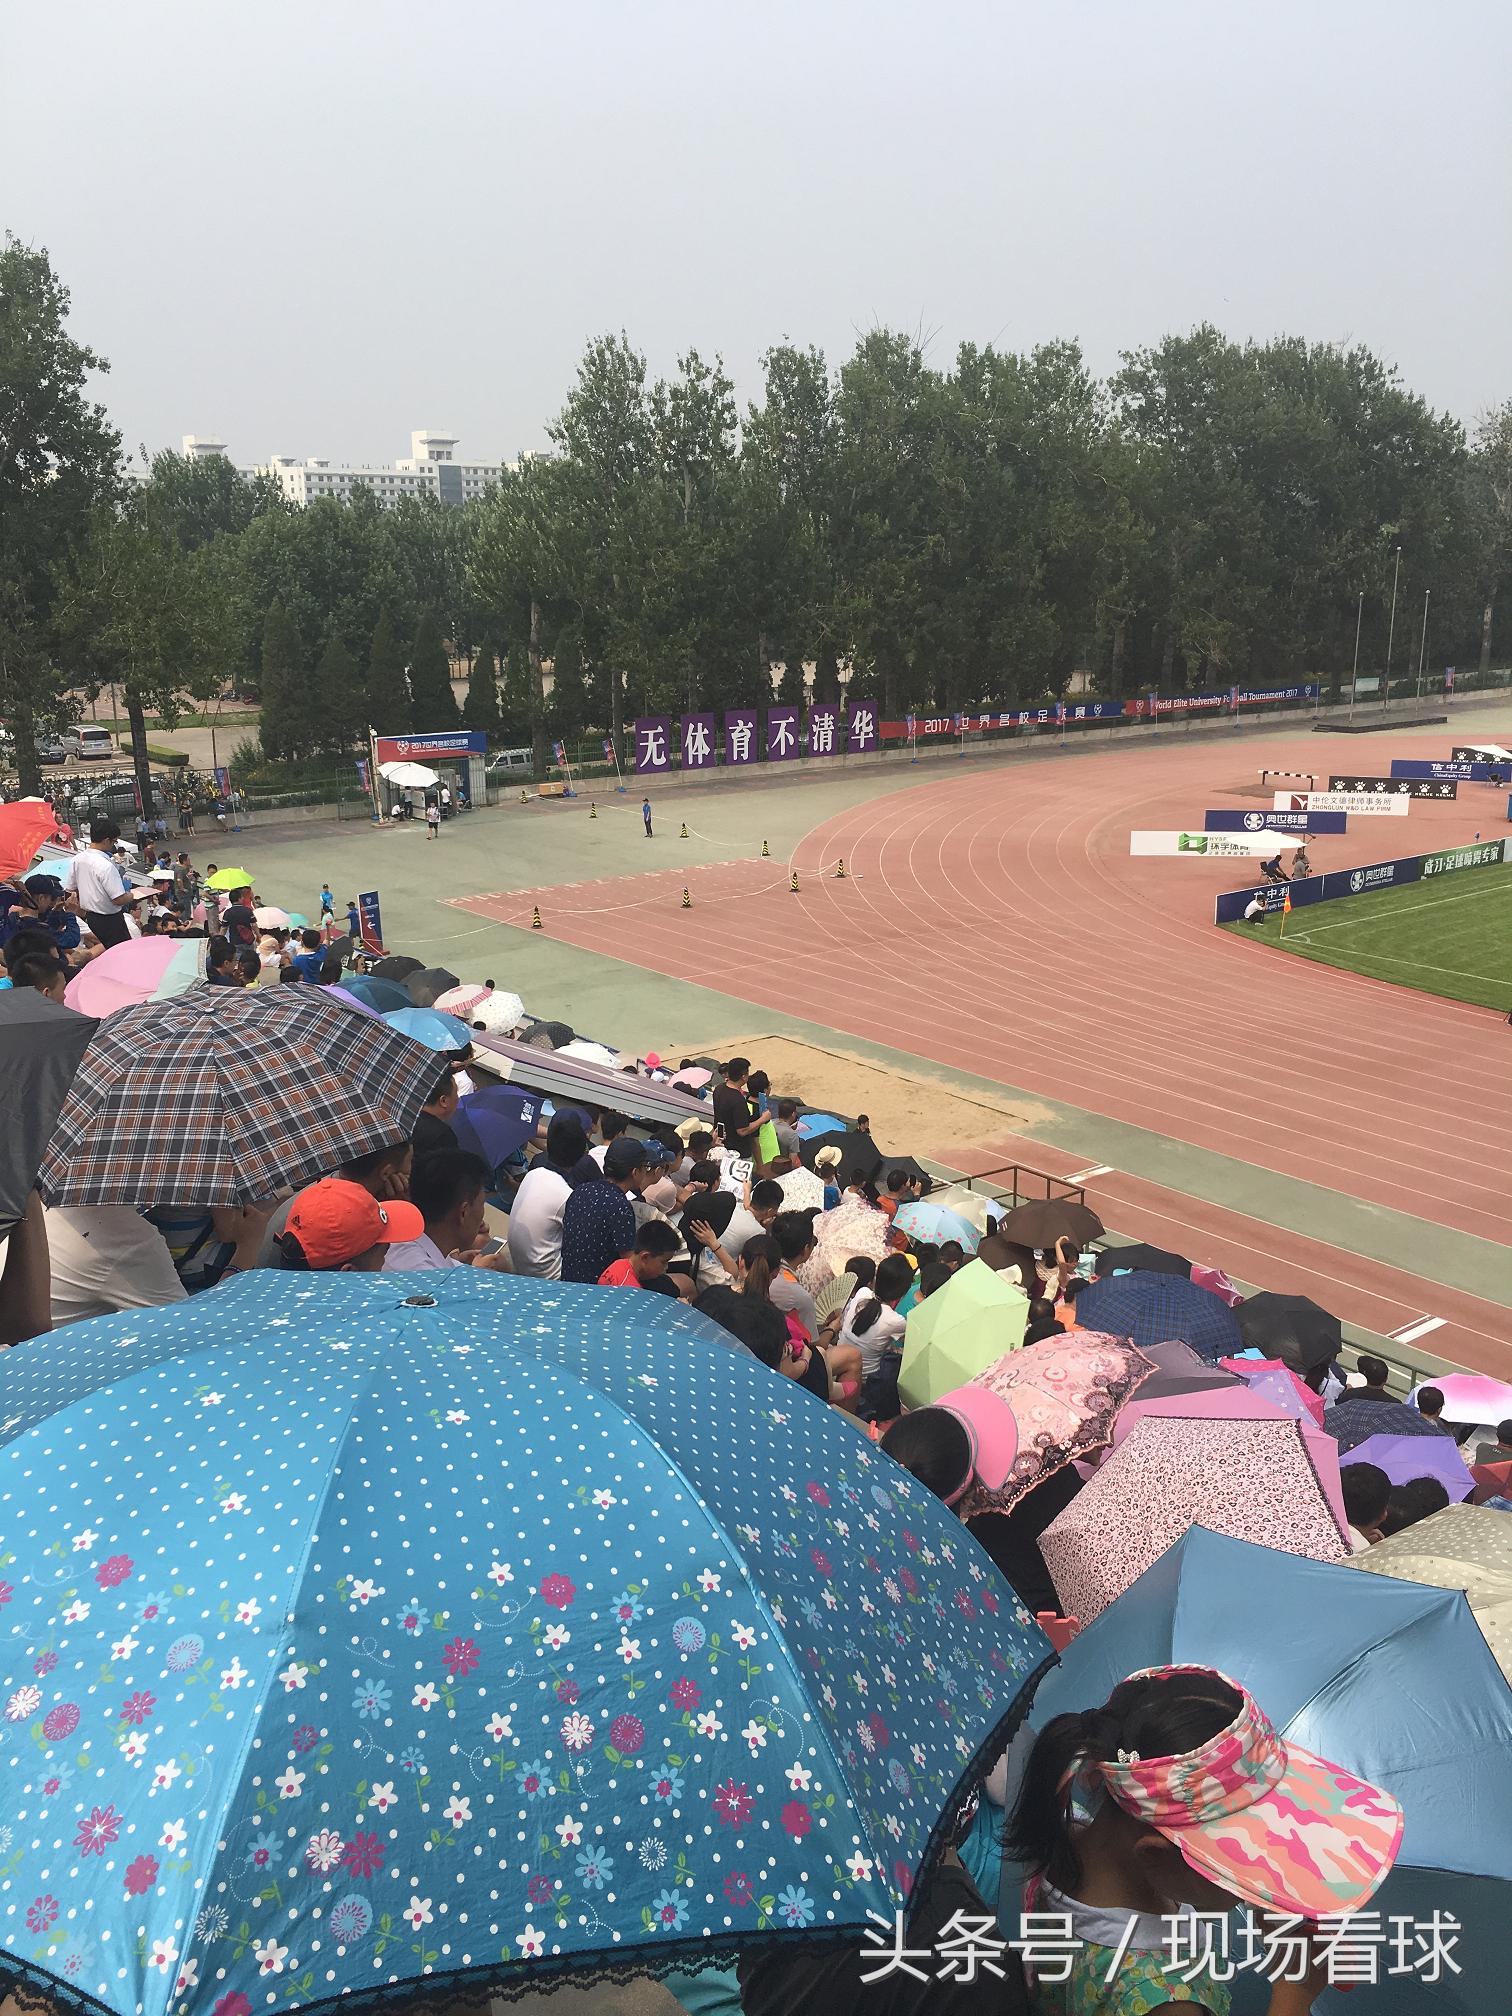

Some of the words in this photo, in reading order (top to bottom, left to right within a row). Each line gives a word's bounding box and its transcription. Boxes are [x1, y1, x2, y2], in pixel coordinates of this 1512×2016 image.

[1173, 698, 1188, 708] Elite
[1189, 693, 1222, 706] University
[1223, 692, 1248, 703] Foall
[1248, 690, 1285, 701] Tournament
[1285, 688, 1298, 698] 2017
[640, 709, 874, 768] 无体育不清华
[1431, 763, 1472, 772] 信中利
[1312, 796, 1392, 806] 中伦文德律师事务所
